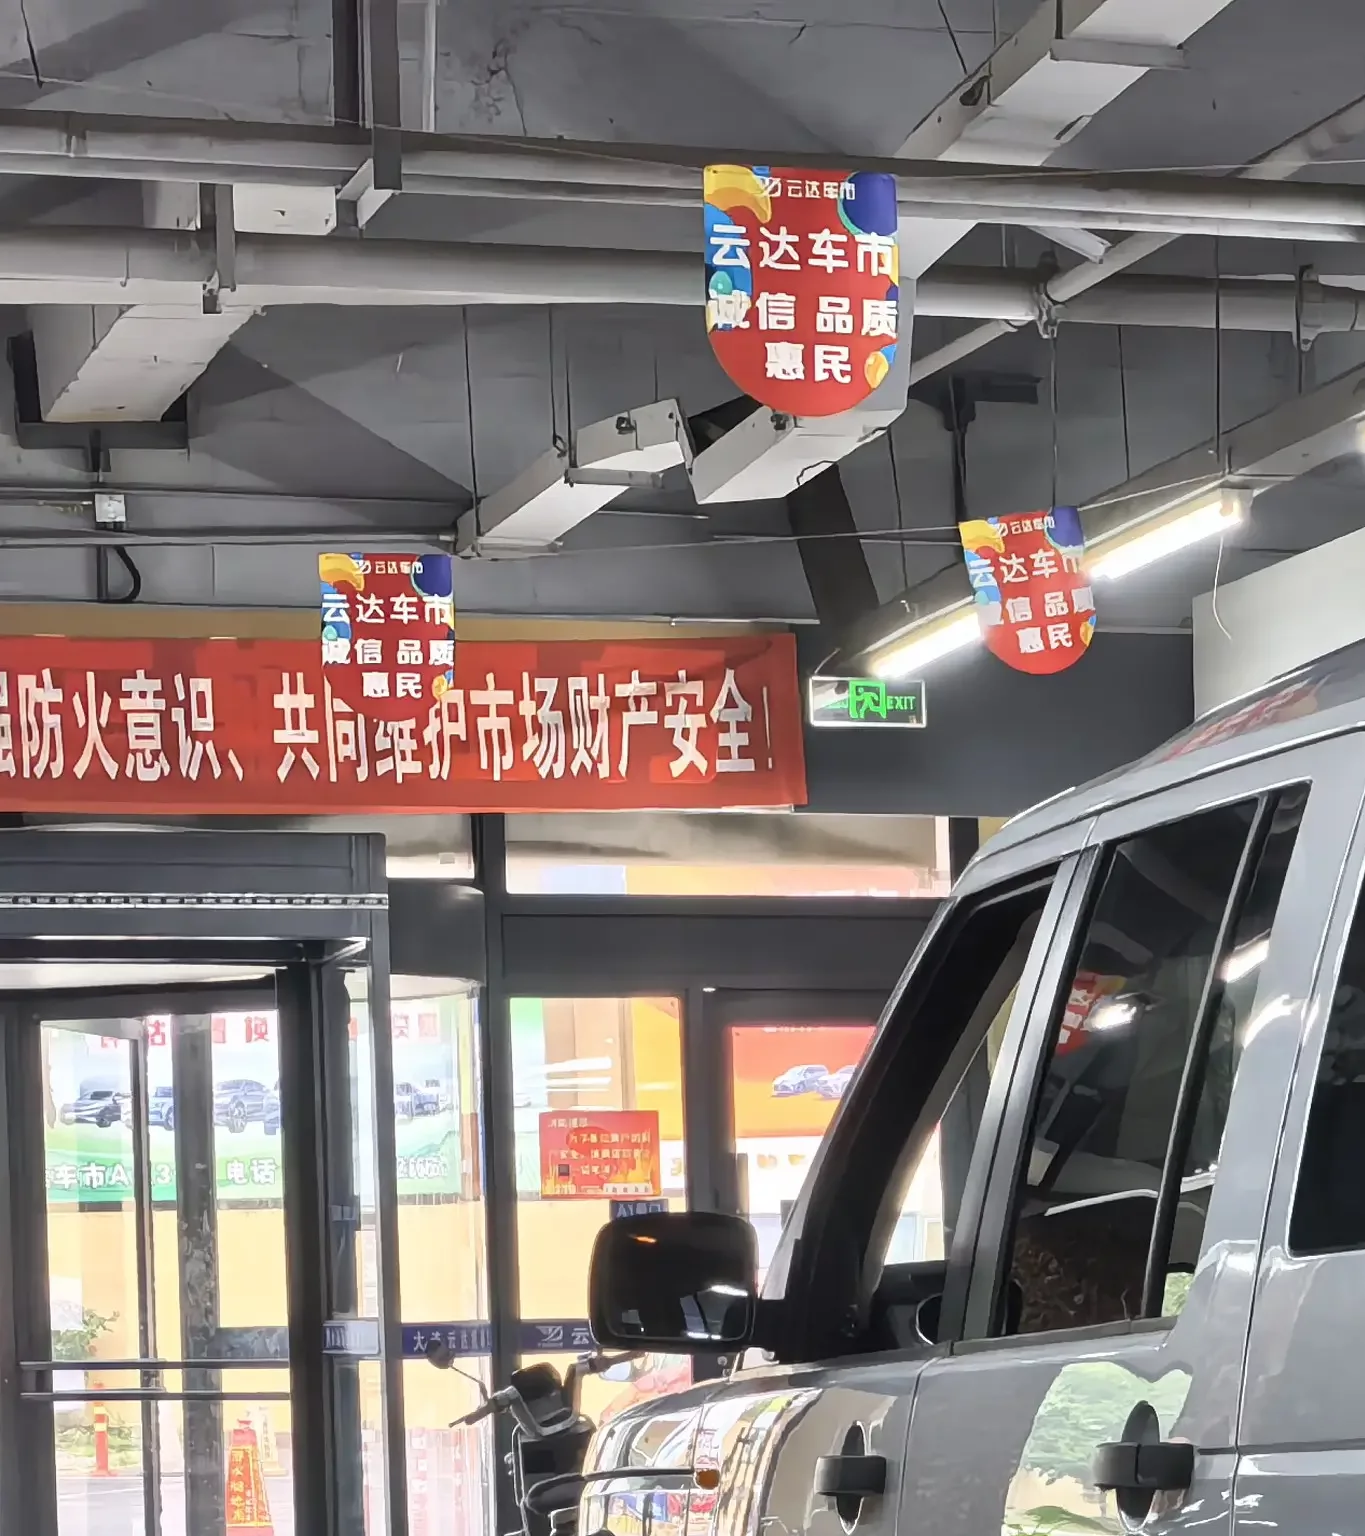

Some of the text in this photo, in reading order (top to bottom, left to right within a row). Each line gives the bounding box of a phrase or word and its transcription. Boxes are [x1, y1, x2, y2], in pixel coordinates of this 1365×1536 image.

[709, 224, 896, 276] 云达车市
[706, 290, 898, 339] 诚信 品质
[765, 341, 853, 384] 惠民
[321, 592, 455, 625] 云达车市
[397, 639, 455, 666] 品质
[886, 695, 916, 710] EXIT
